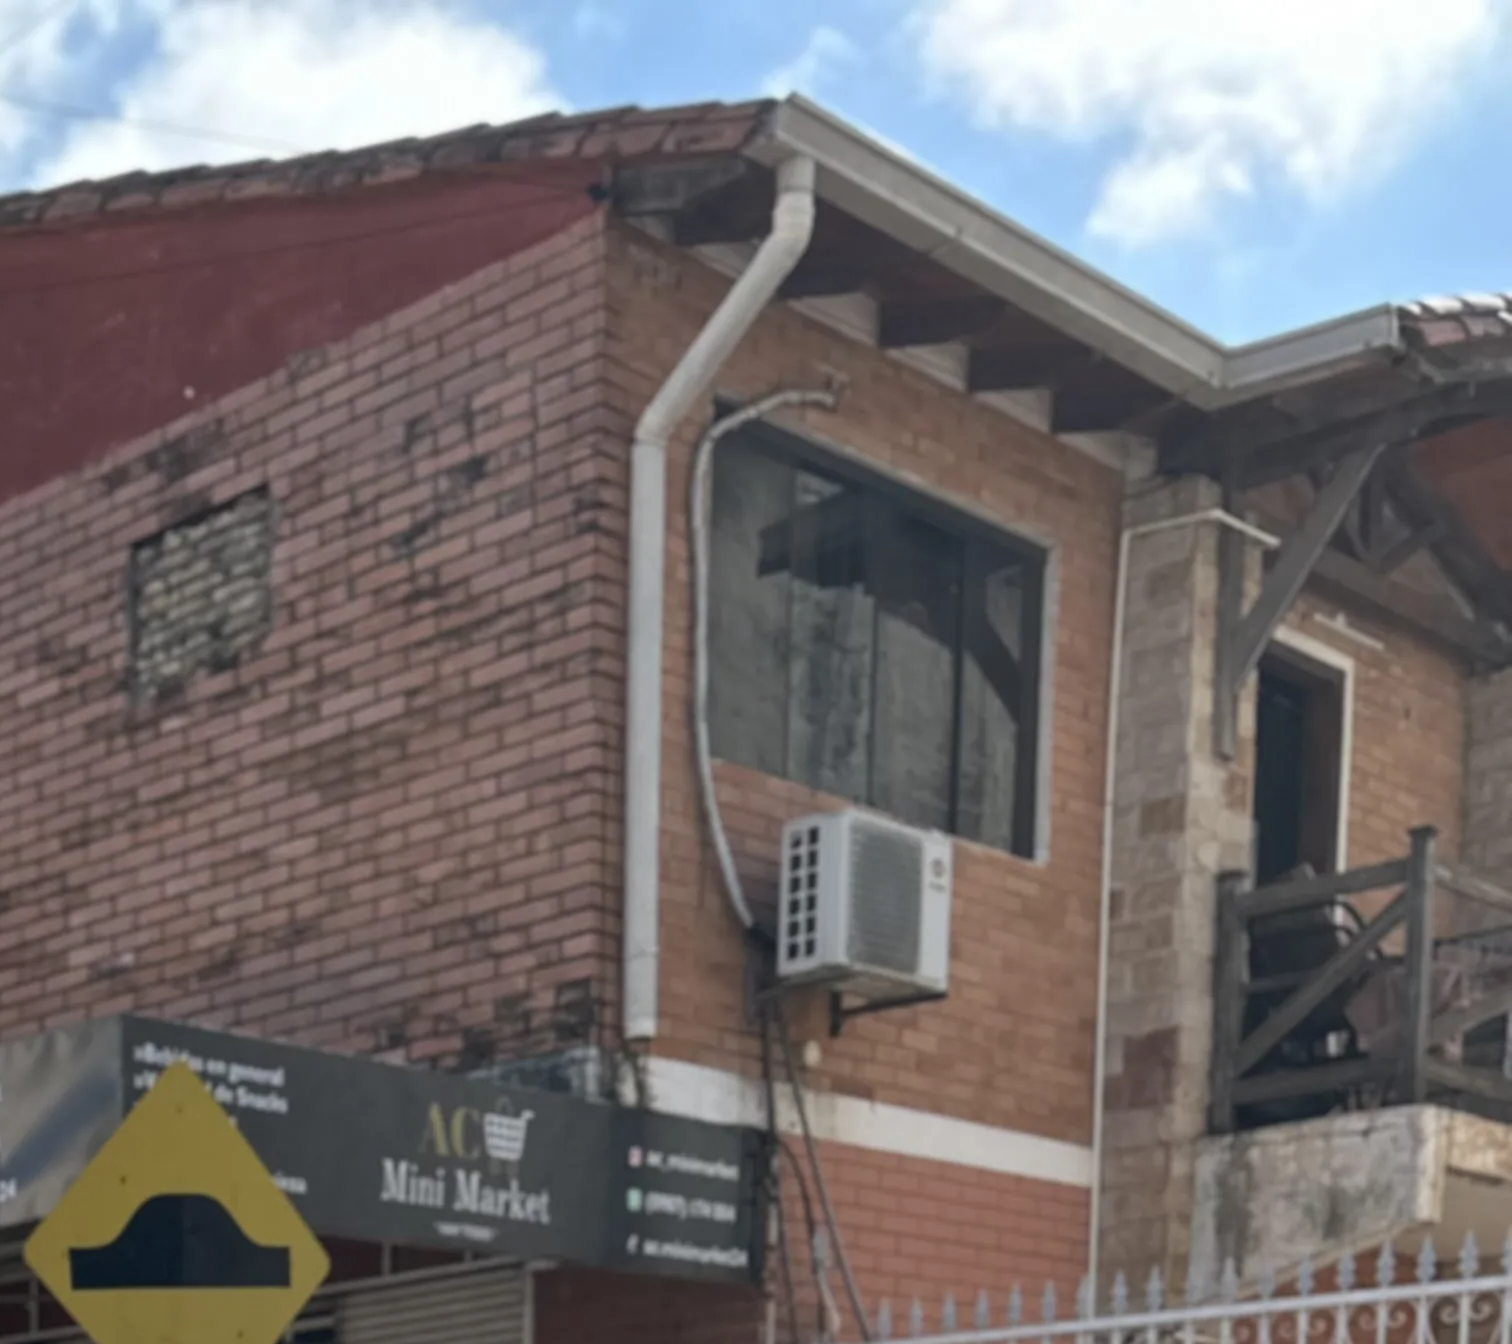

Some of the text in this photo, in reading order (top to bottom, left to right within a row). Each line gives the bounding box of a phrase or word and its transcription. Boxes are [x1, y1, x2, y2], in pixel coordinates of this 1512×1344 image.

[206, 1057, 227, 1077] en
[228, 1062, 285, 1087] general
[237, 1086, 289, 1114] Snacks
[418, 1101, 481, 1160] AC
[380, 1157, 551, 1225] Mini Market
